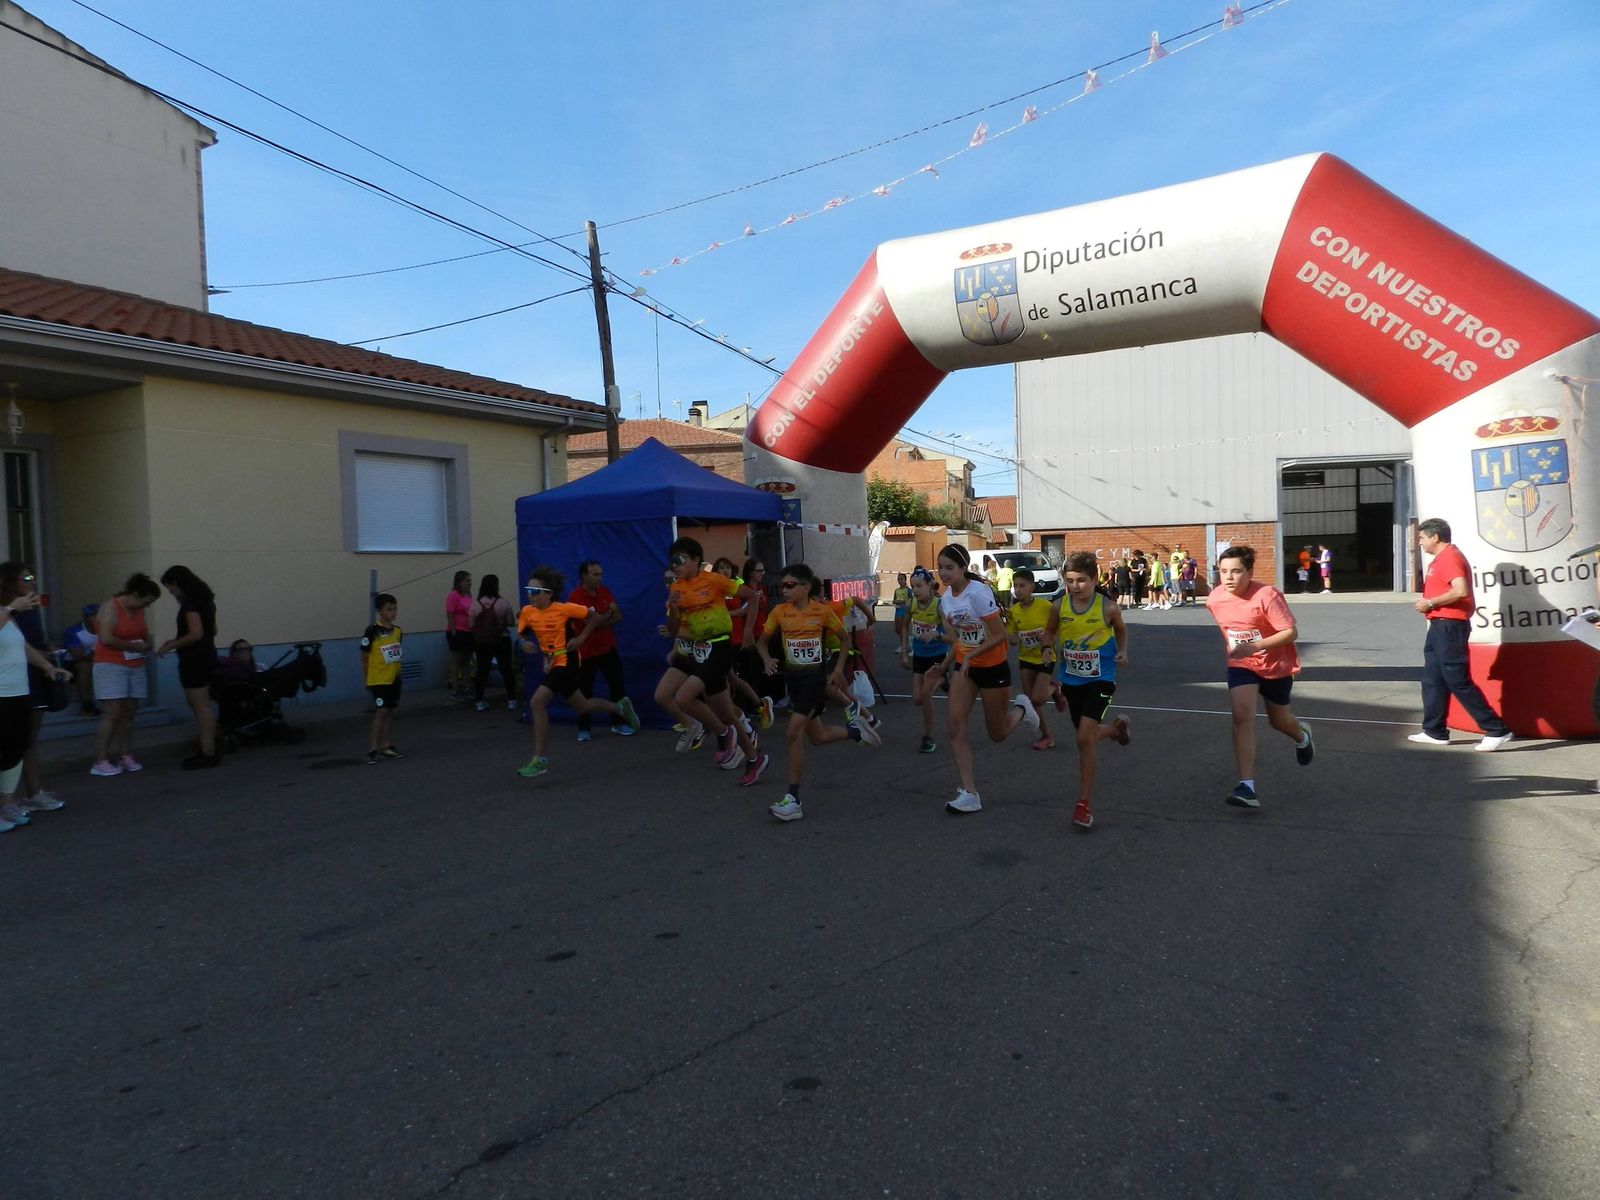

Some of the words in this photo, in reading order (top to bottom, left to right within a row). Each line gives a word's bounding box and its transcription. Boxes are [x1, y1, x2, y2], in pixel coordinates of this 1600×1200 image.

[1023, 227, 1164, 275] Diputación
[1028, 303, 1050, 321] de
[1058, 276, 1198, 316] Salamanca
[1309, 226, 1370, 270] CON
[1367, 261, 1521, 360] NUESTROS
[1295, 260, 1478, 382] DEPORTISTAS
[764, 411, 796, 448] CON
[792, 382, 816, 411] EL
[813, 300, 884, 386] DEPORTE
[1473, 558, 1599, 593] iputació
[793, 648, 814, 658] 515
[1070, 660, 1093, 671] 523
